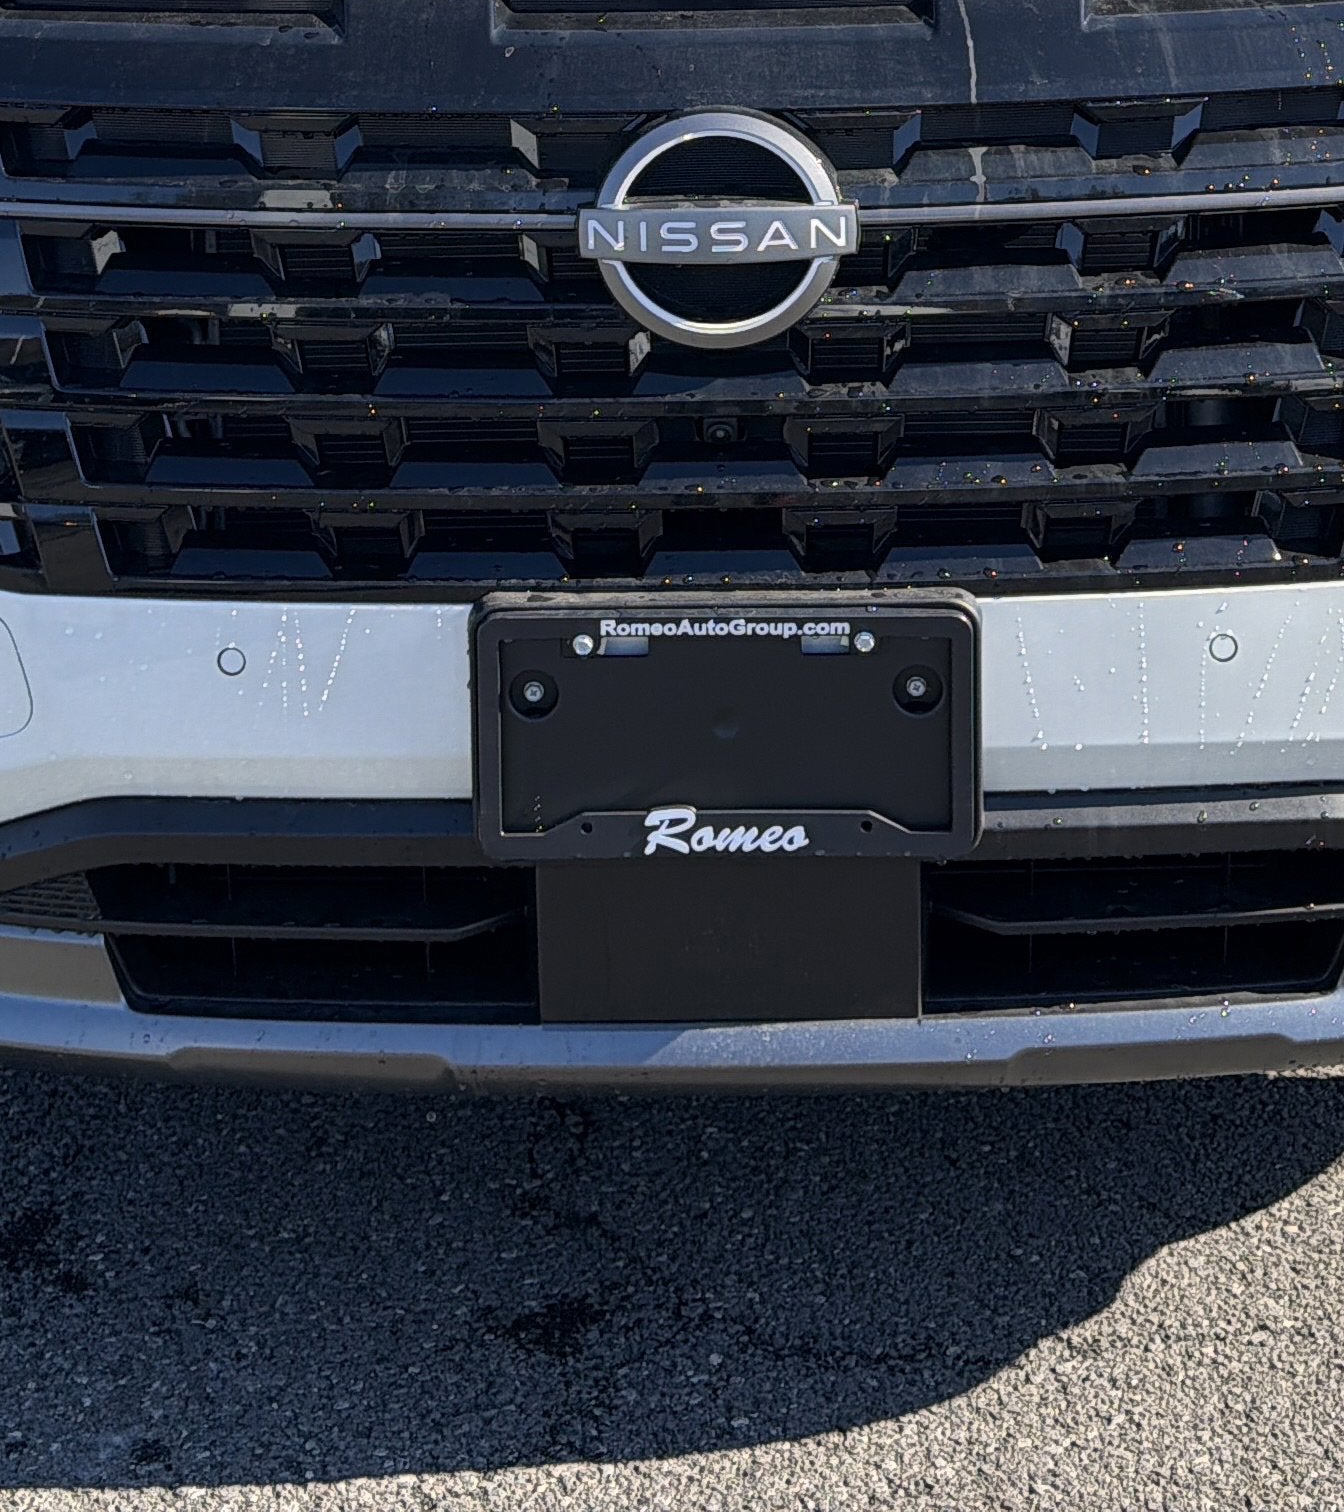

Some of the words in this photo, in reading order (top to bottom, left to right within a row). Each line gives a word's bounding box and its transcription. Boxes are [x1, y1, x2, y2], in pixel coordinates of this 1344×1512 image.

[587, 216, 847, 253] NISSAN
[600, 619, 851, 638] RomeoAutoGroup.com
[644, 807, 809, 855] Romeo
